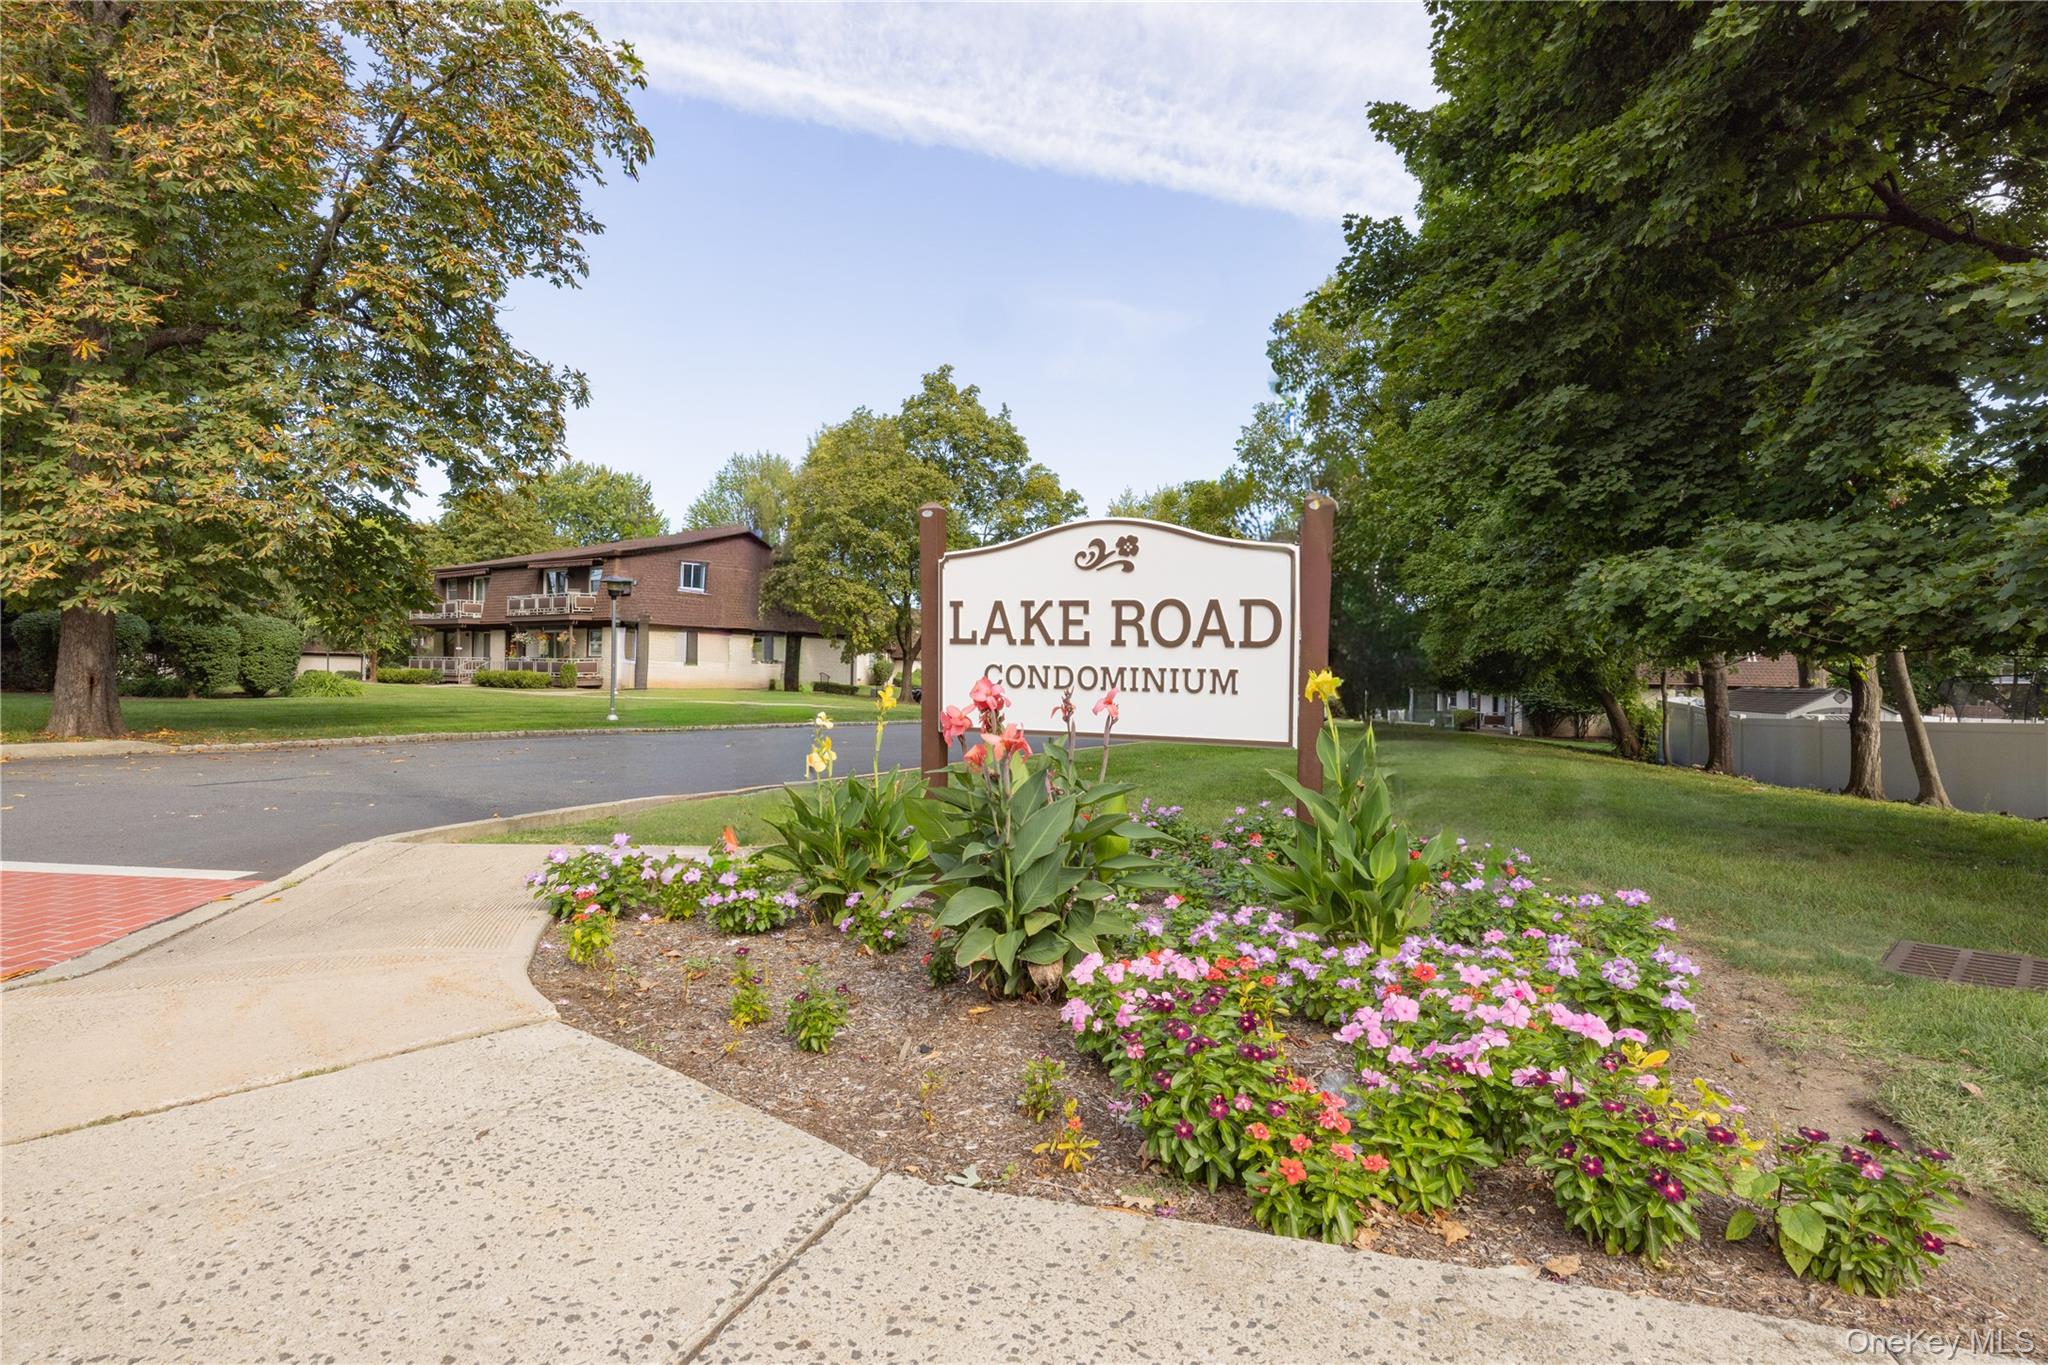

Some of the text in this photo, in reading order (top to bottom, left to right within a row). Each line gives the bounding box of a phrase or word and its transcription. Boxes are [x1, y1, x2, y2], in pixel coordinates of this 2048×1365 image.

[949, 598, 1282, 648] LAKE ROAD
[984, 664, 1239, 695] CONDOMINIUM
